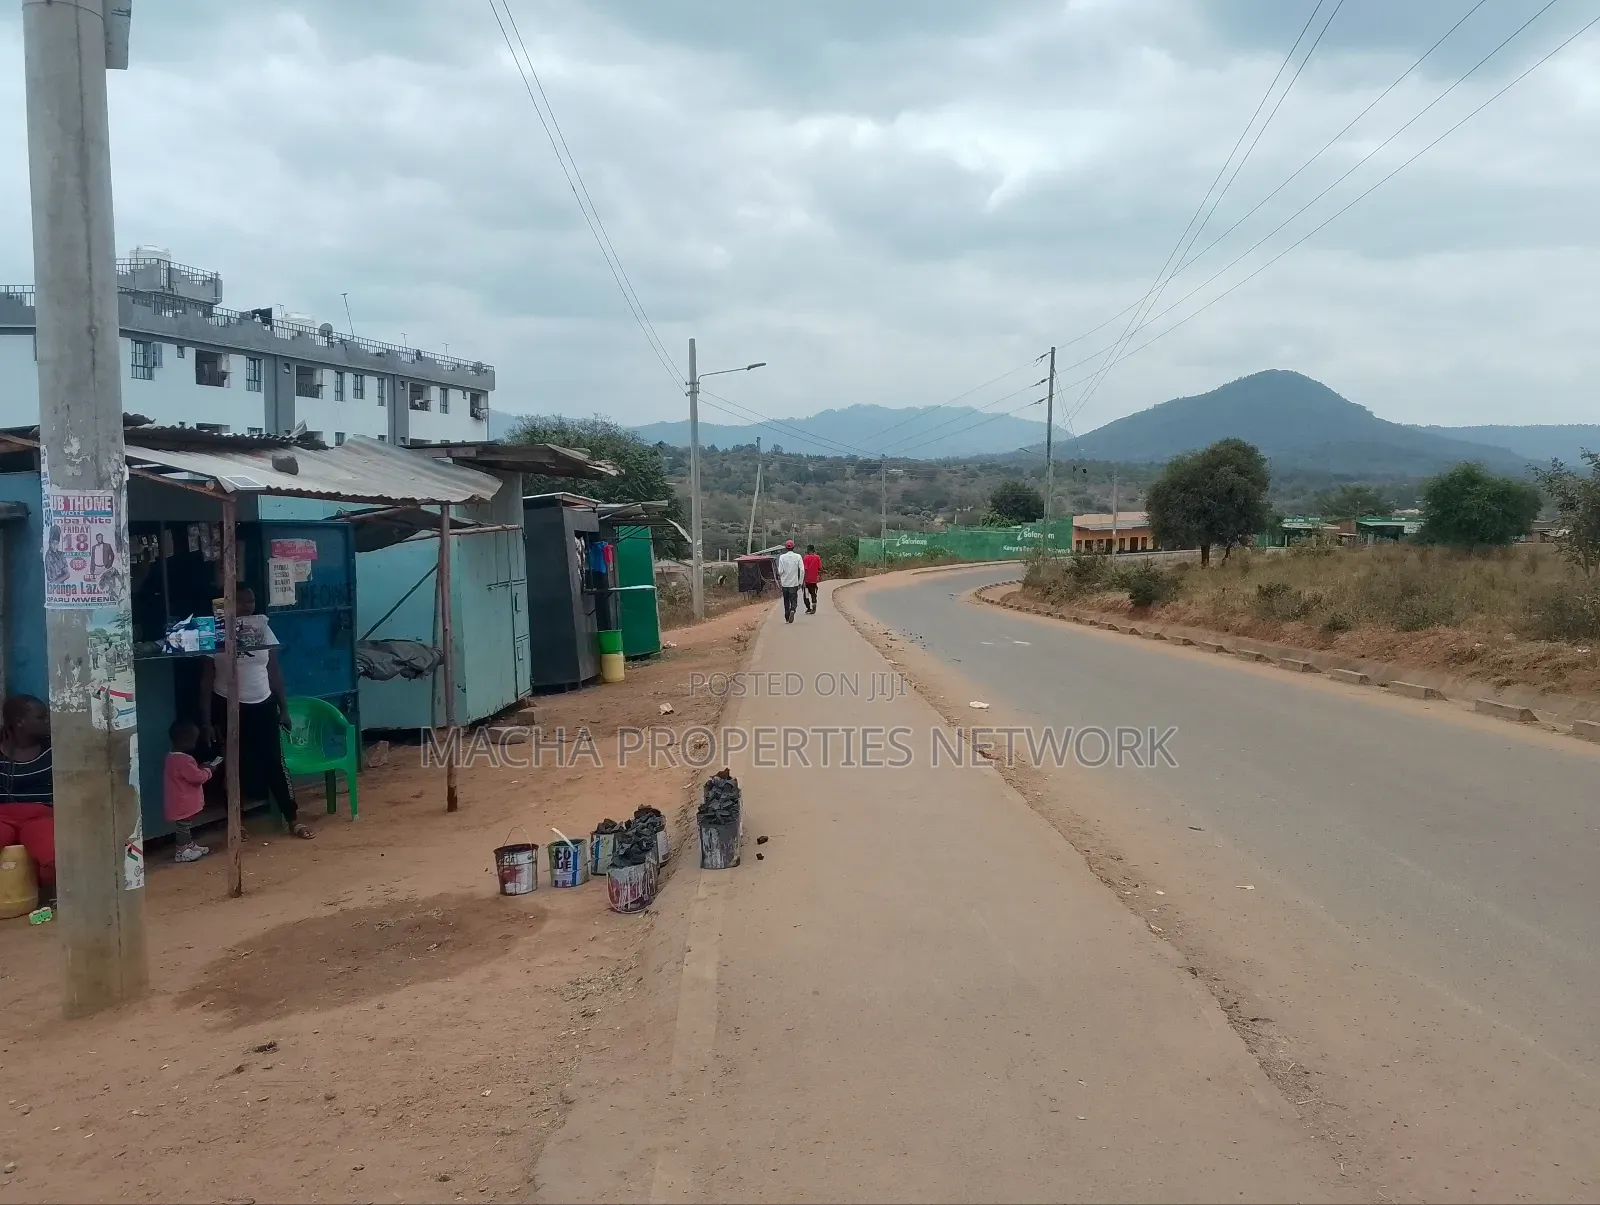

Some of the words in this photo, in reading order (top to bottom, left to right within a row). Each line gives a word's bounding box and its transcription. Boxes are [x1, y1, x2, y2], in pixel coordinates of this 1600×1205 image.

[68, 496, 112, 511] THOME
[63, 525, 90, 534] FRIDAY
[64, 534, 89, 552] 18
